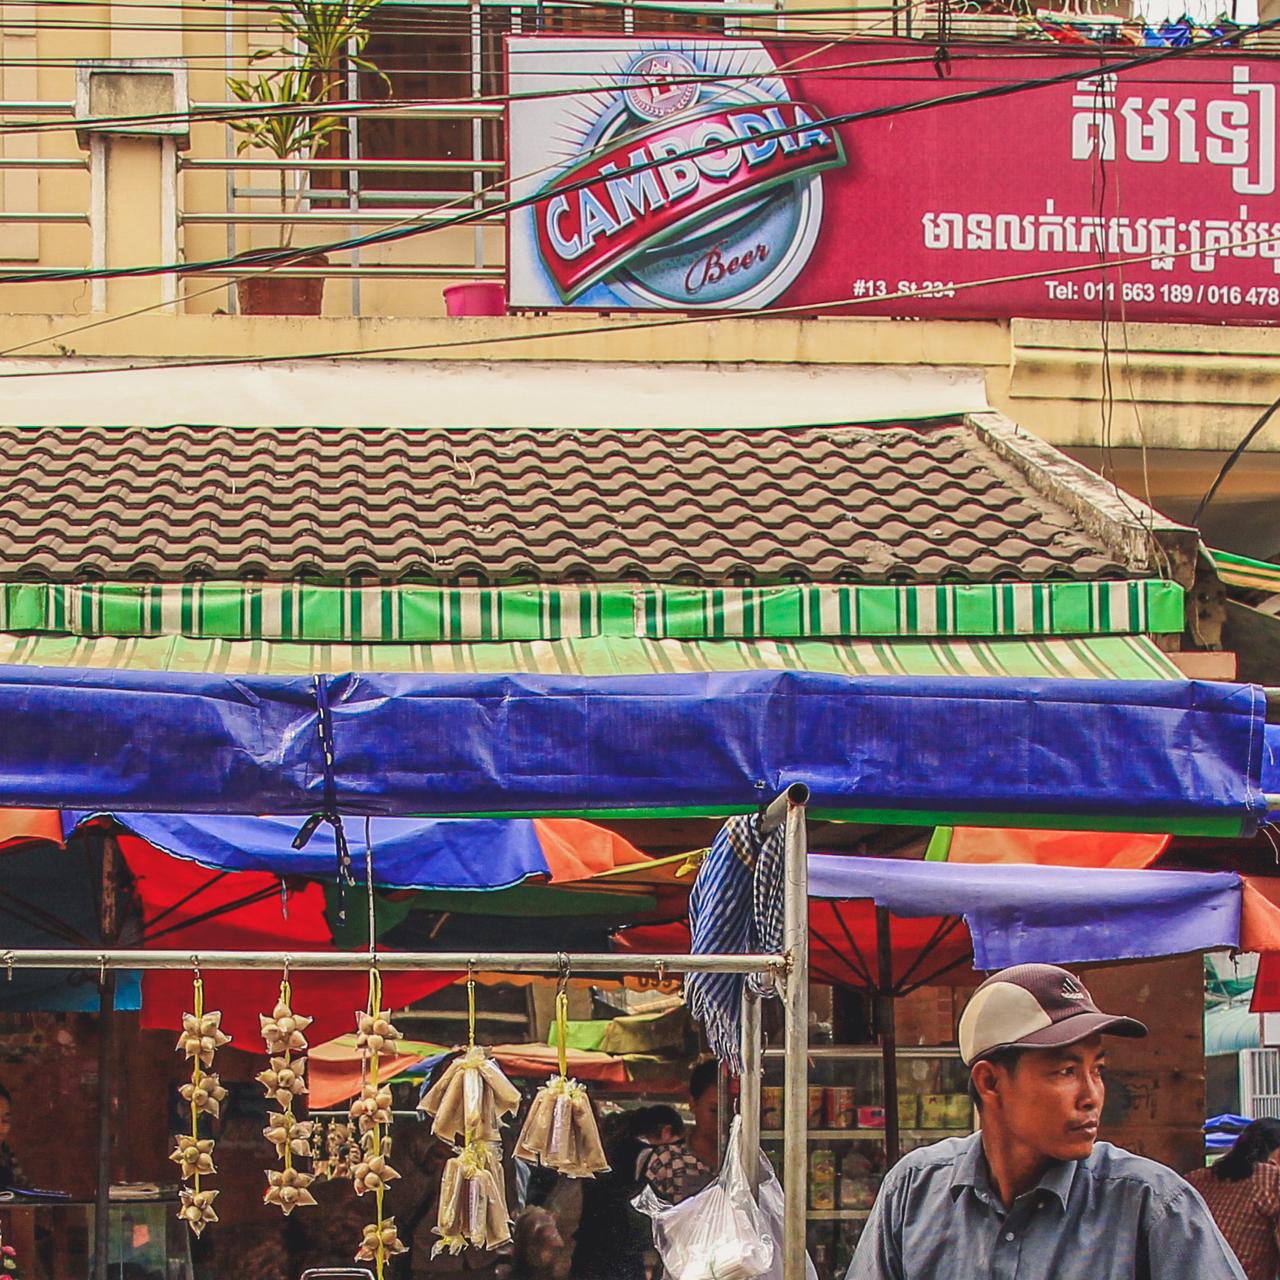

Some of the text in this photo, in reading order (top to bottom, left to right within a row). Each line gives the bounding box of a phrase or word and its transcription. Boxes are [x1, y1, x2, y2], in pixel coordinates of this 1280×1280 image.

[545, 104, 832, 262] CAMBODIA
[684, 239, 771, 297] Beer
[853, 279, 887, 297] #13
[1044, 280, 1079, 300] Tel:
[1083, 281, 1115, 302] 011
[1122, 282, 1155, 303] 663
[1161, 284, 1193, 304] 189
[1196, 284, 1205, 304] /
[1208, 285, 1242, 305] 016
[1246, 286, 1280, 306] 478
